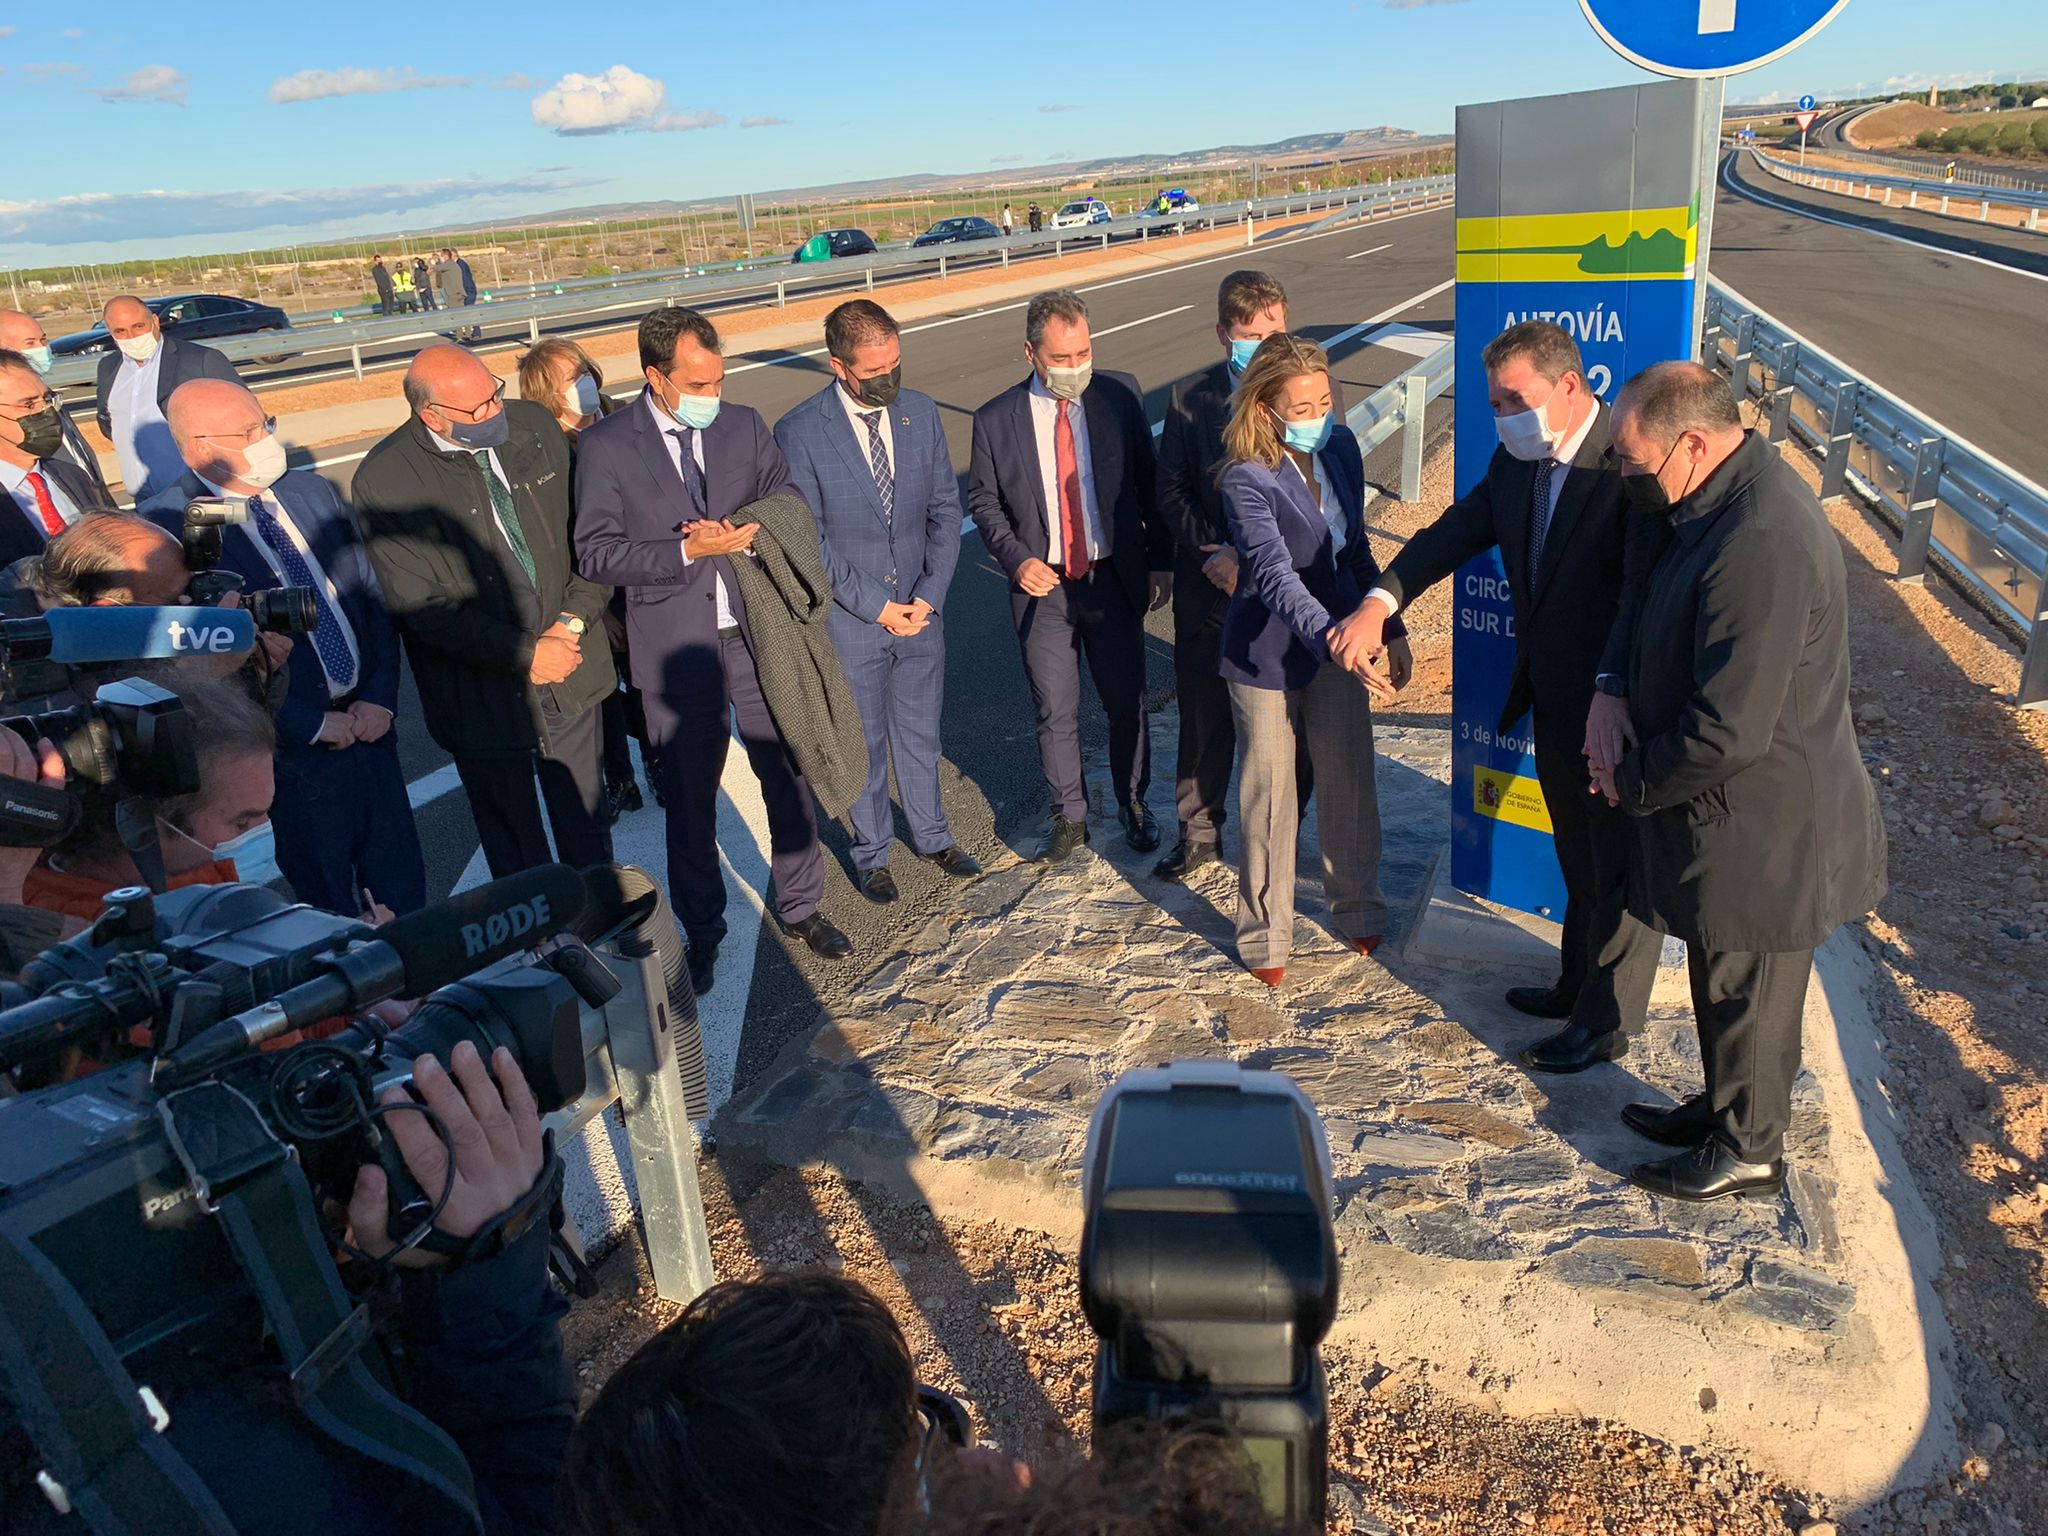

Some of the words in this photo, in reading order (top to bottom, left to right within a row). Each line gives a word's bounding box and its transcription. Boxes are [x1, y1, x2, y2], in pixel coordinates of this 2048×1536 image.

[1503, 302, 1624, 342] AOVÍA
[1465, 574, 1511, 602] CIRC
[1461, 607, 1500, 635] SUR
[167, 620, 235, 653] tve
[1461, 721, 1470, 740] 3
[1473, 725, 1490, 745] de
[5, 800, 60, 820] Panasonic
[1506, 790, 1542, 806] GOBIERNO
[1506, 799, 1516, 808] DE
[1516, 801, 1542, 814] ESPAÑA
[460, 894, 551, 959] RØDE
